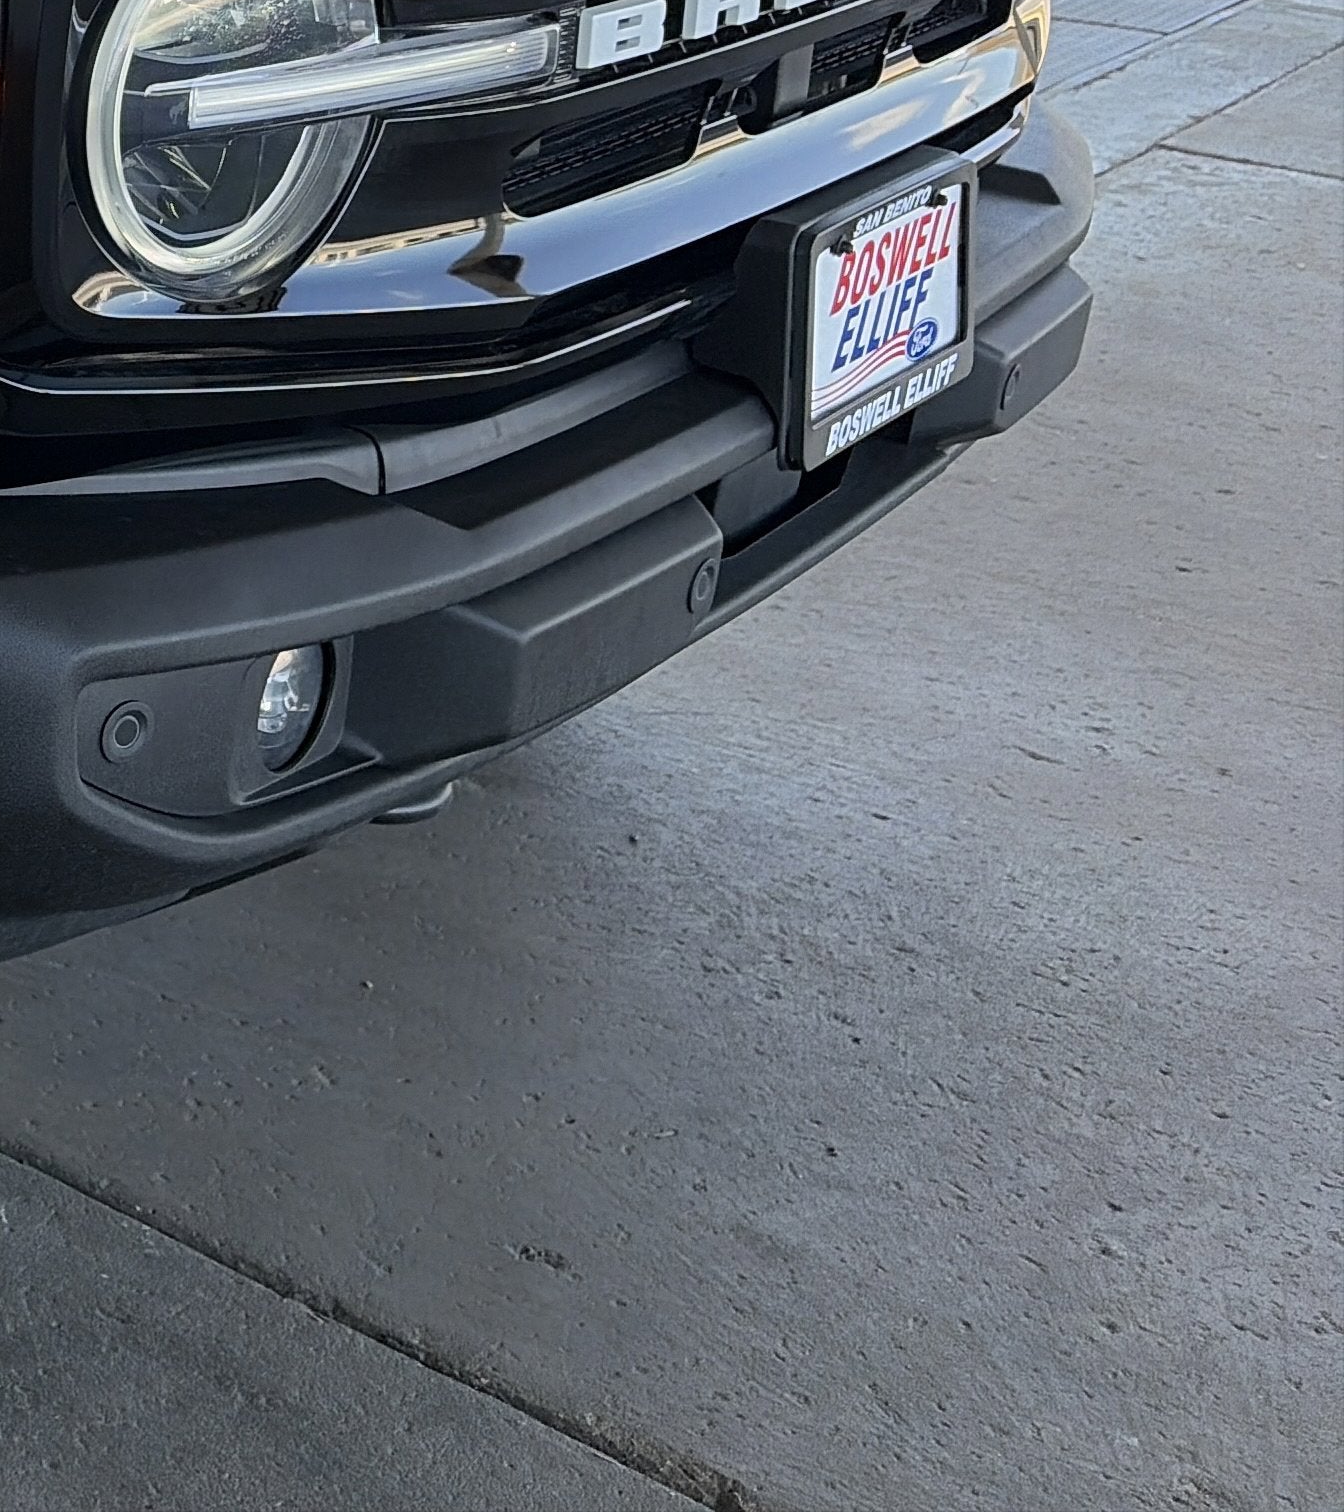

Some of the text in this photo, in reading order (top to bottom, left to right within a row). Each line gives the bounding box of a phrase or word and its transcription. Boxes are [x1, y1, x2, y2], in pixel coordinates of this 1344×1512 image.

[829, 202, 957, 317] BOSWELL
[853, 184, 932, 238] SAN BENITO
[831, 267, 935, 373] ELLIFF
[825, 353, 959, 457] BOSWELL ELLIFF
